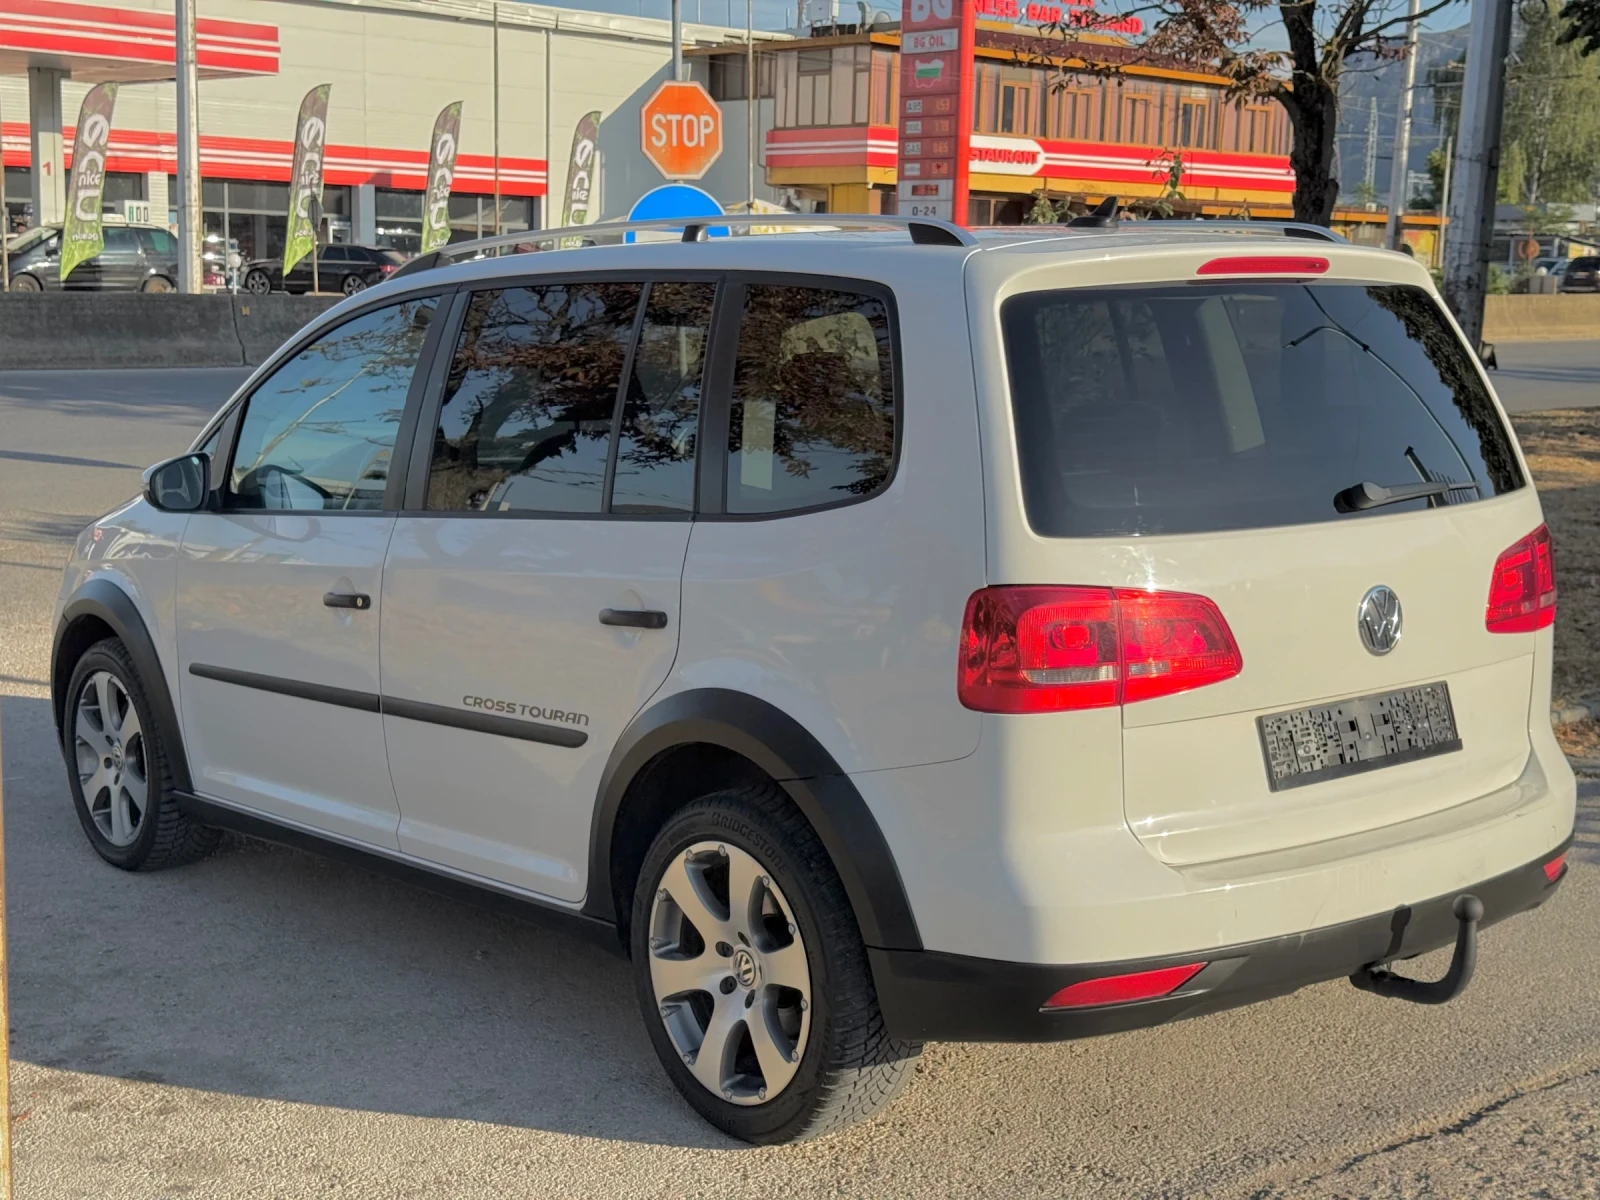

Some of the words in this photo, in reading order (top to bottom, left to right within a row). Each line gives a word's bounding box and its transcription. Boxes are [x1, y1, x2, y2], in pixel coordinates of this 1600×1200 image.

[1027, 4, 1062, 22] BAR
[928, 35, 946, 47] OIL
[651, 113, 714, 147] STOP
[43, 161, 51, 176] 1
[912, 206, 937, 216] 0-24
